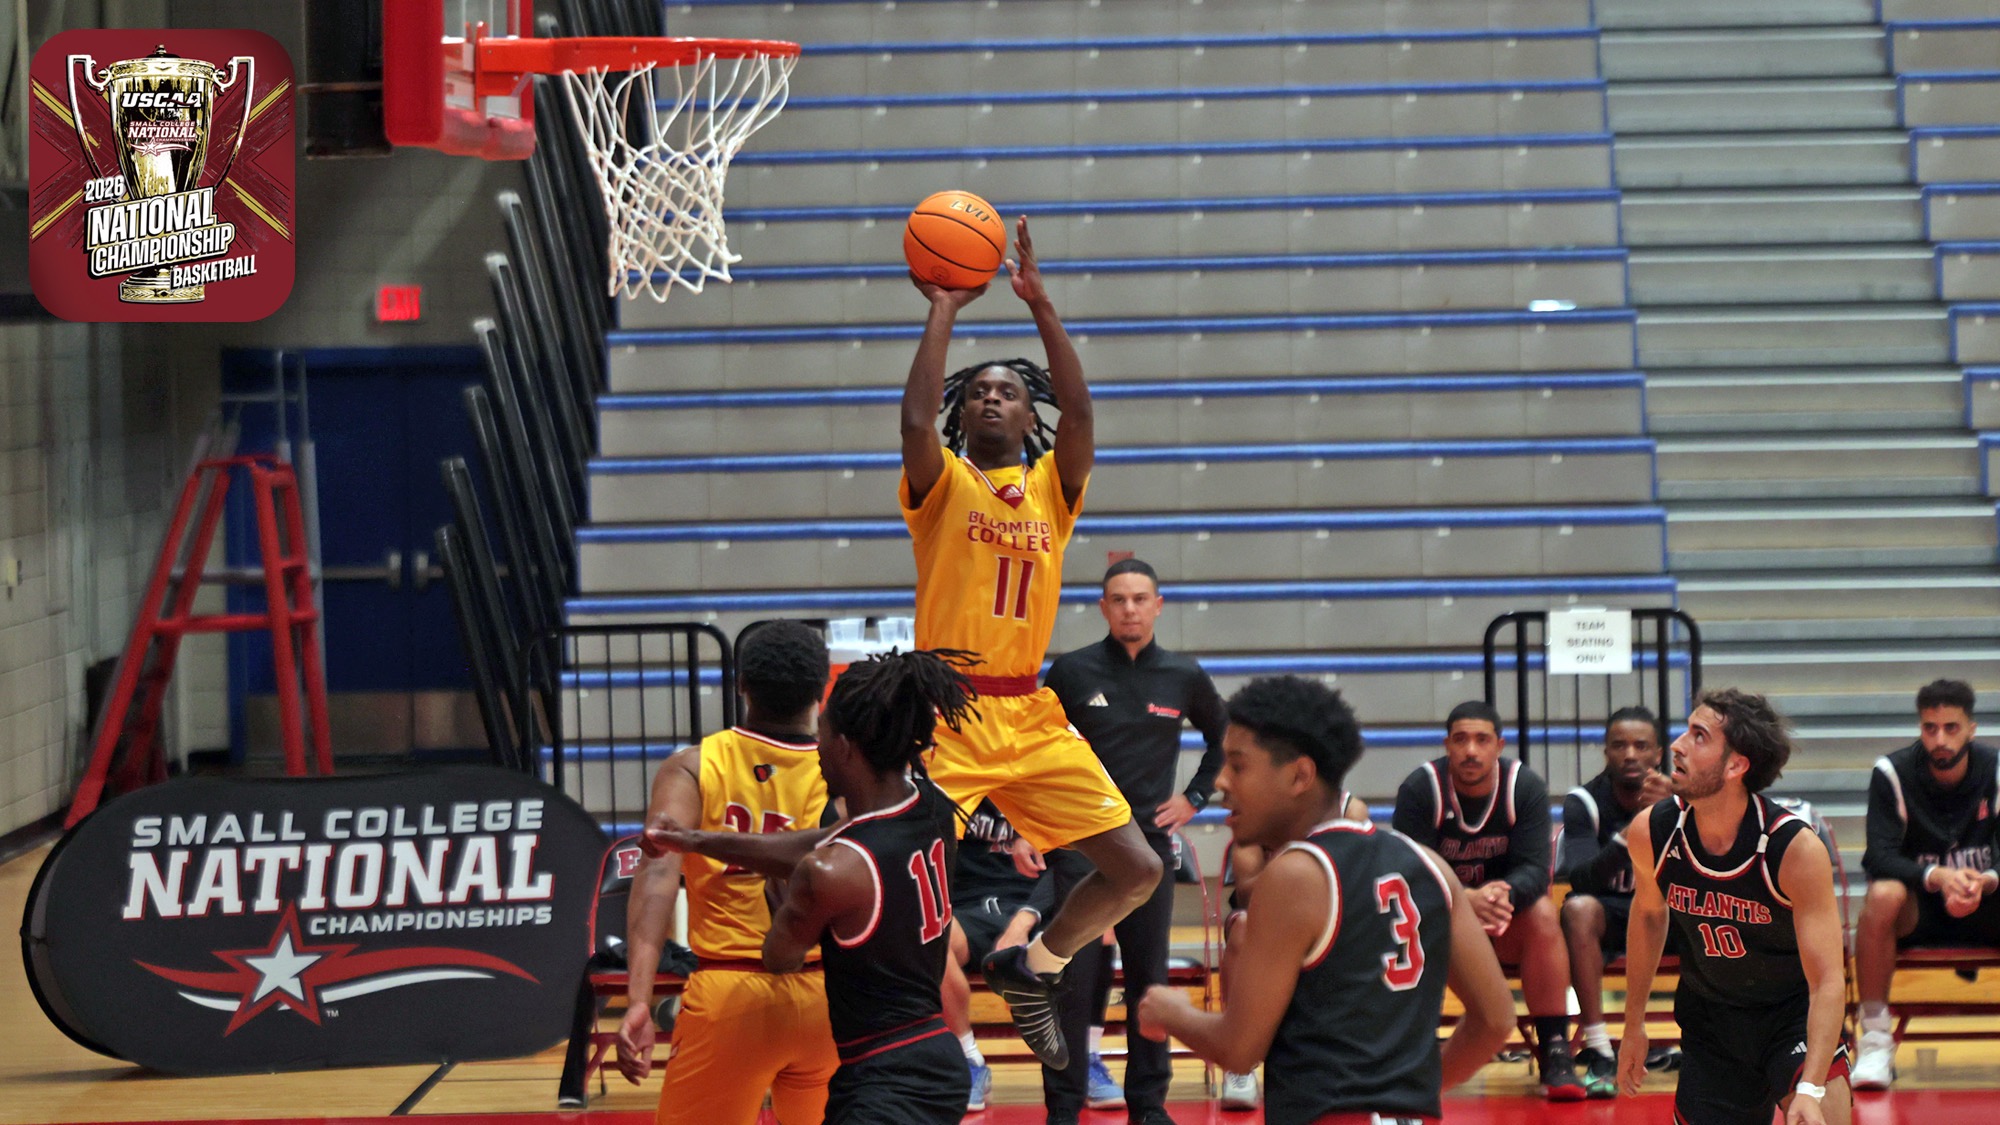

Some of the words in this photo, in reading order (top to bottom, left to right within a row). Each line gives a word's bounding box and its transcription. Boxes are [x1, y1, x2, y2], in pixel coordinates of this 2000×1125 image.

[992, 555, 1035, 621] 11
[1567, 637, 1615, 649] SEATING
[1576, 621, 1606, 632] TEAM
[1576, 654, 1606, 665] ONLY
[132, 812, 307, 848] SMALL
[325, 799, 545, 840] COLLEGE
[123, 834, 555, 920] NATIONAL
[908, 837, 953, 946] 11
[310, 905, 553, 936] CHAMPIONSHIPS
[1667, 882, 1773, 925] ATLANTIS
[1374, 872, 1426, 992] 3
[1698, 922, 1747, 960] 10
